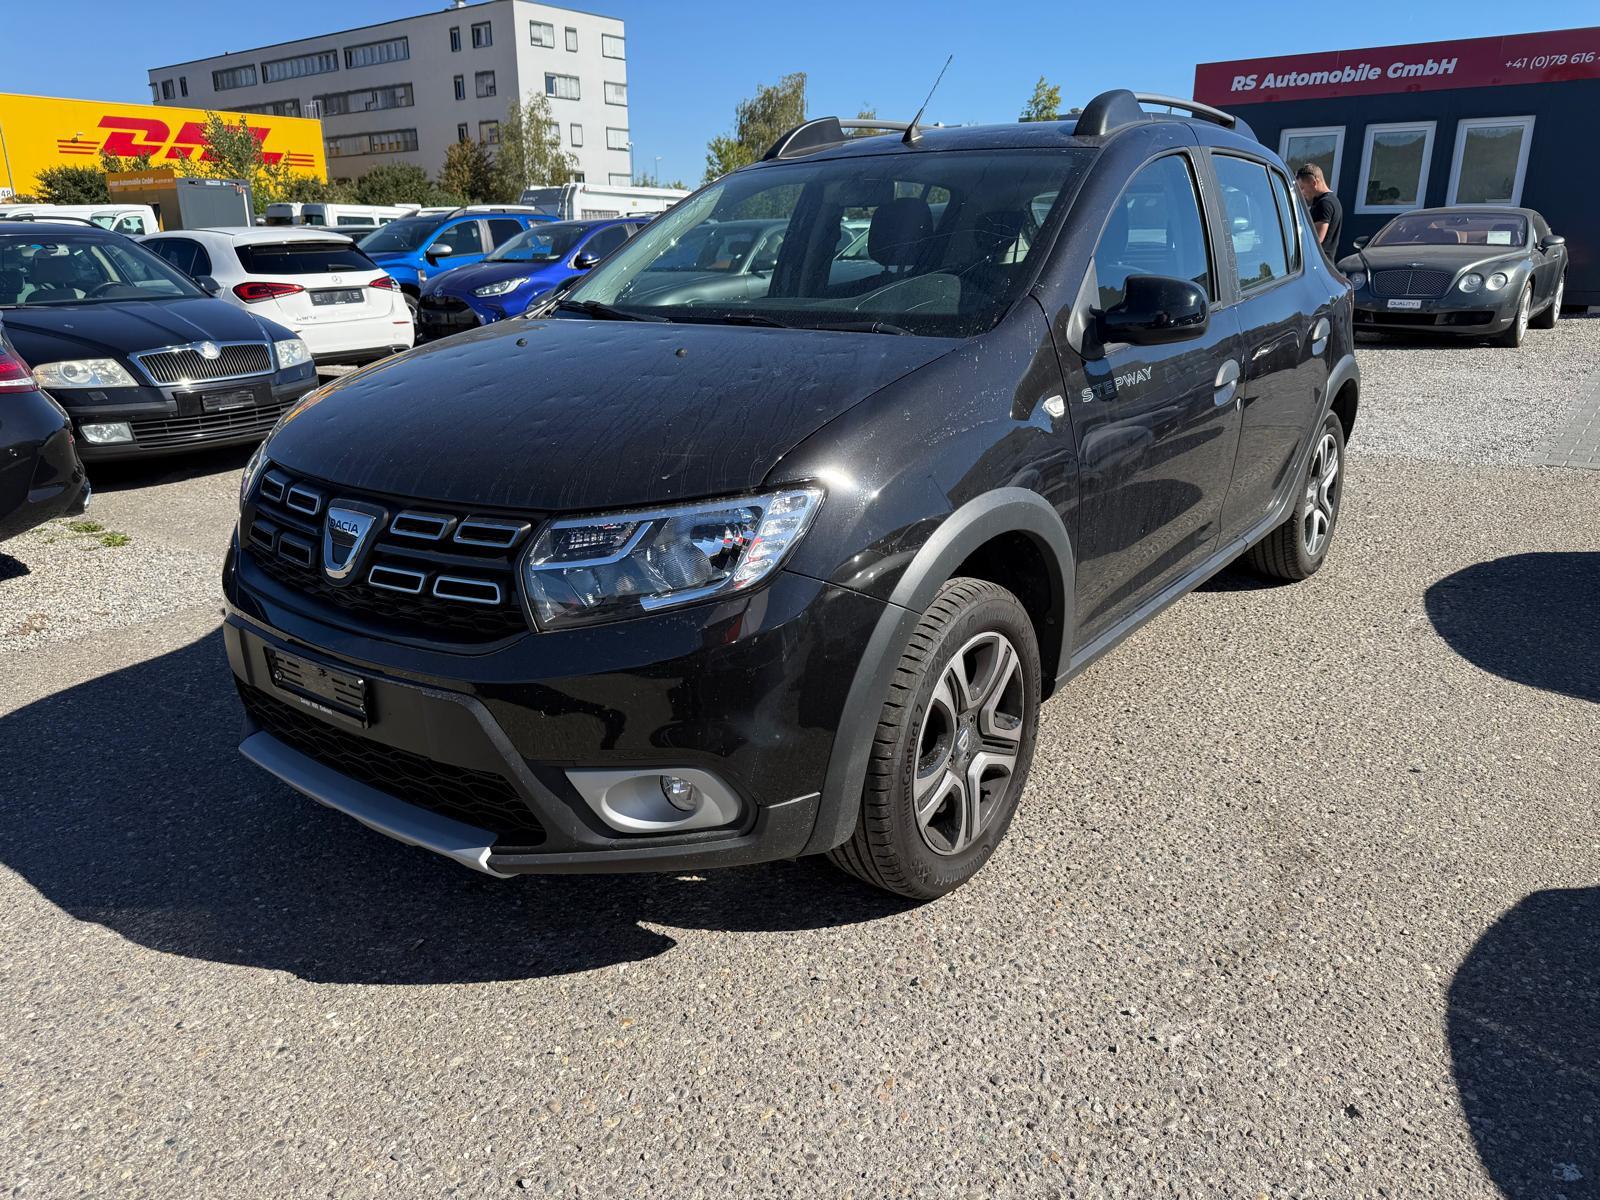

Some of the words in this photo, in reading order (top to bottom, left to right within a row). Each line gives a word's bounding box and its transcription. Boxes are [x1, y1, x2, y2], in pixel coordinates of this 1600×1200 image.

[1231, 74, 1258, 91] RS
[1260, 63, 1382, 90] Automobile
[1386, 58, 1458, 80] GmbH
[1505, 56, 1528, 70] +41
[1530, 54, 1568, 70] (0)78
[1570, 51, 1596, 65] 616
[1081, 366, 1152, 403] STEPWAY
[328, 518, 359, 534] DACIA
